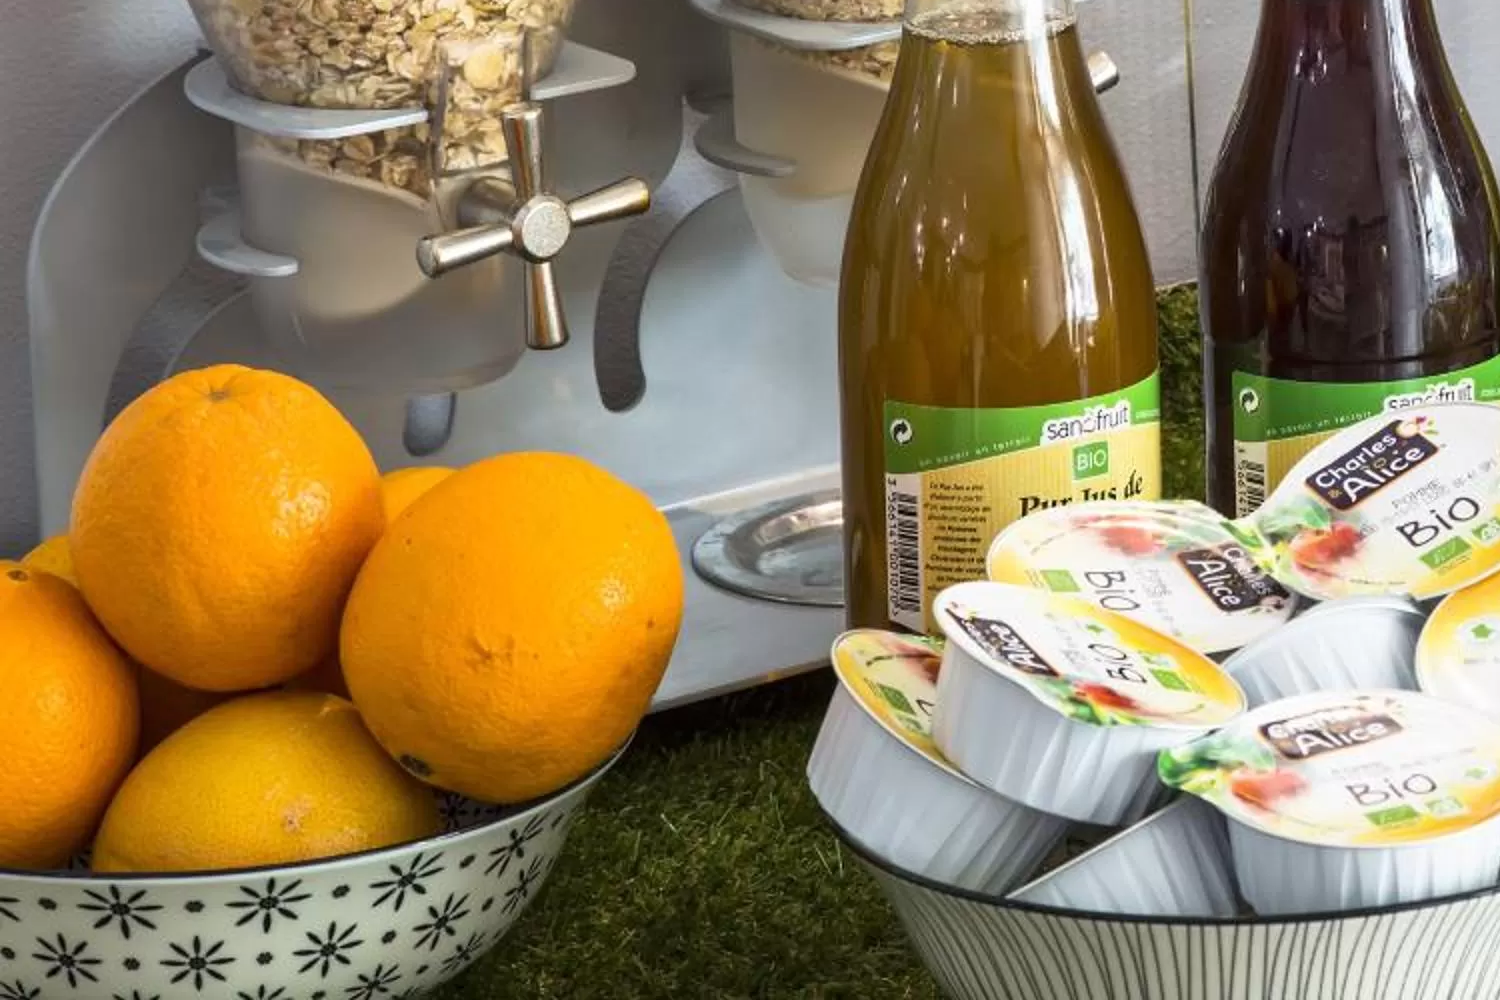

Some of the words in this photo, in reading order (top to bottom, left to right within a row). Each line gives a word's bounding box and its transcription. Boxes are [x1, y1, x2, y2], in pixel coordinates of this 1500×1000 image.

[1076, 448, 1107, 471] BIO
[1315, 434, 1398, 489] Charles
[1343, 446, 1425, 503] Alice
[1123, 468, 1143, 499] de
[1187, 559, 1241, 605] Alice
[1295, 721, 1388, 756] Alice
